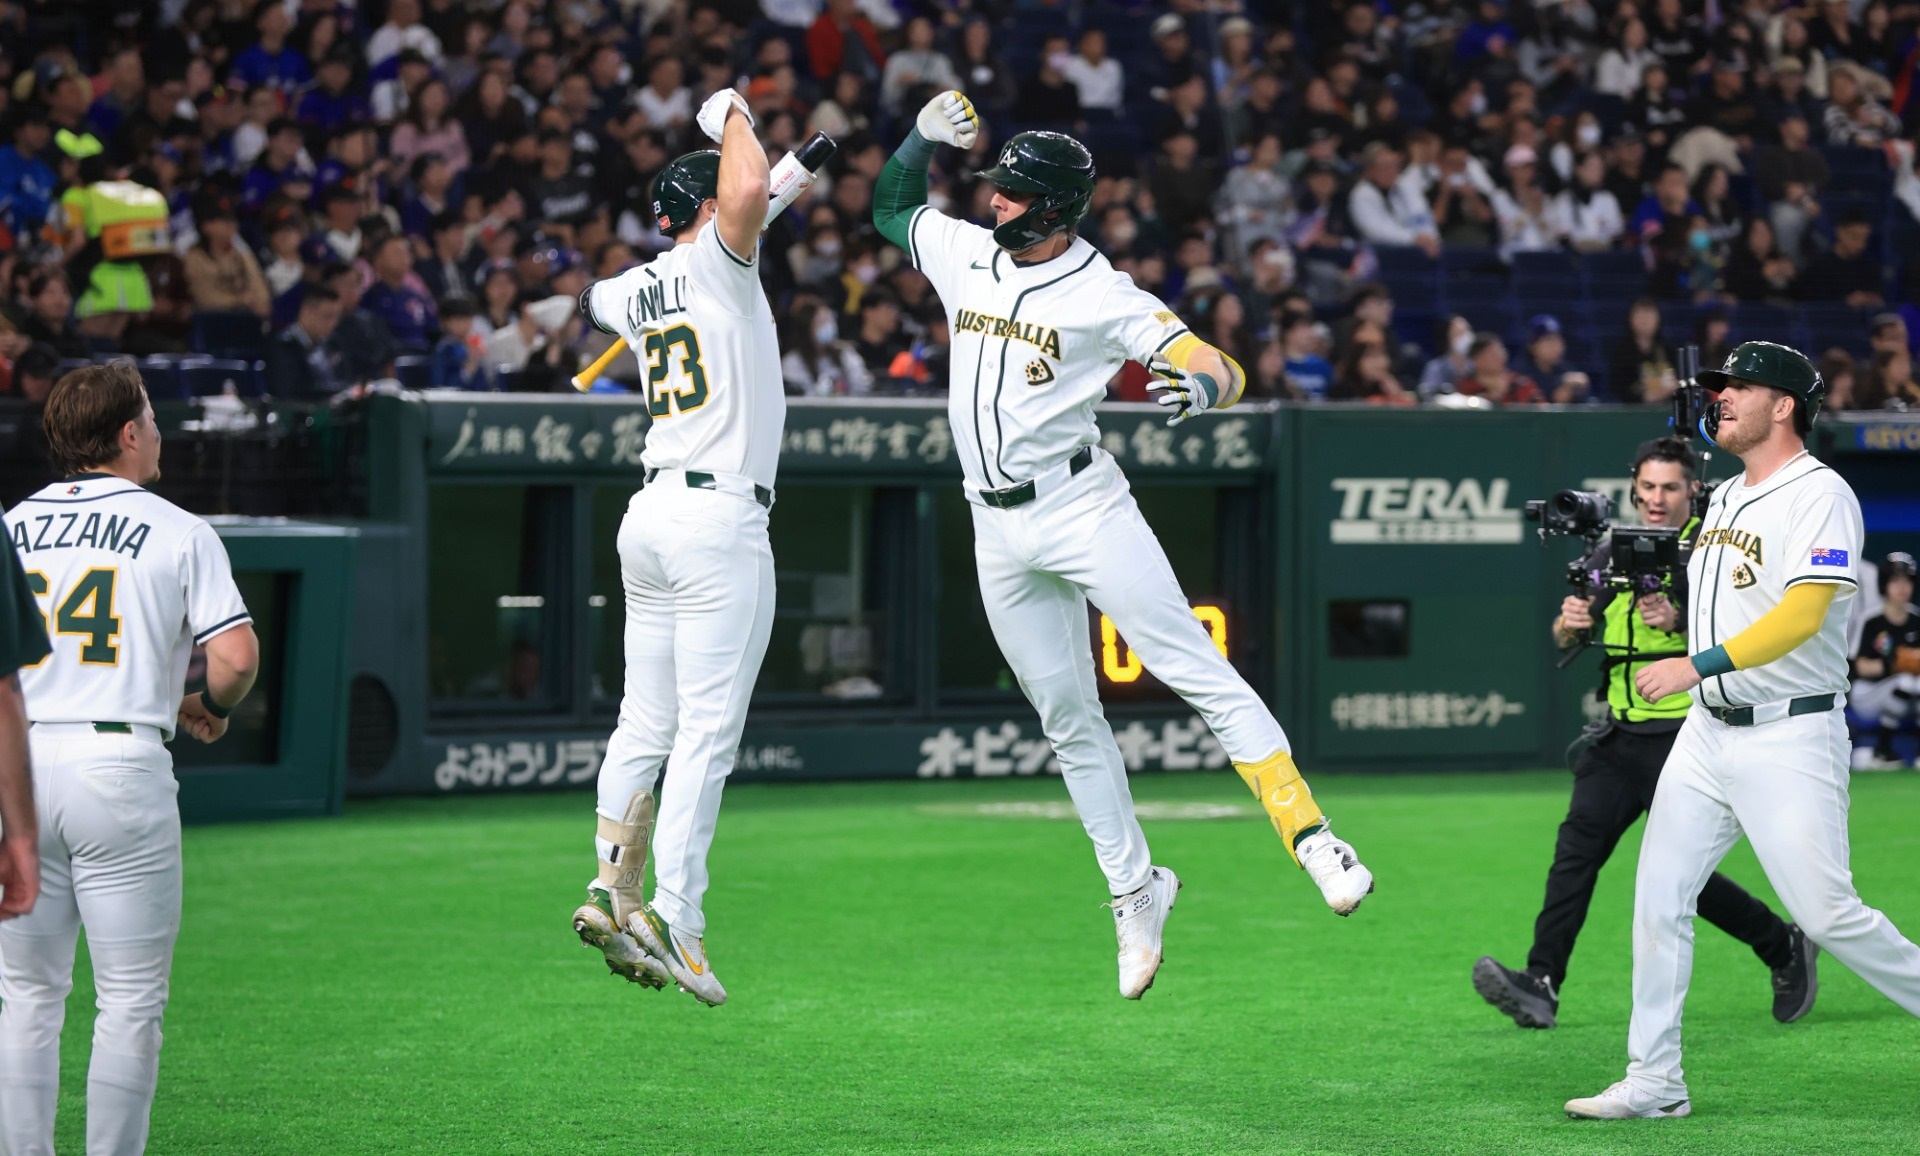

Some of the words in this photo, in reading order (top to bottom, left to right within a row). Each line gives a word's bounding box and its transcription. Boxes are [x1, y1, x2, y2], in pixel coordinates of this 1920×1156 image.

[954, 308, 1062, 362] AUSTRALIA
[645, 322, 711, 418] 23
[1330, 477, 1524, 519] TERAL
[13, 512, 151, 560] AZZANA
[434, 739, 607, 790] よみうりラ
[916, 719, 1060, 778] オービッ
